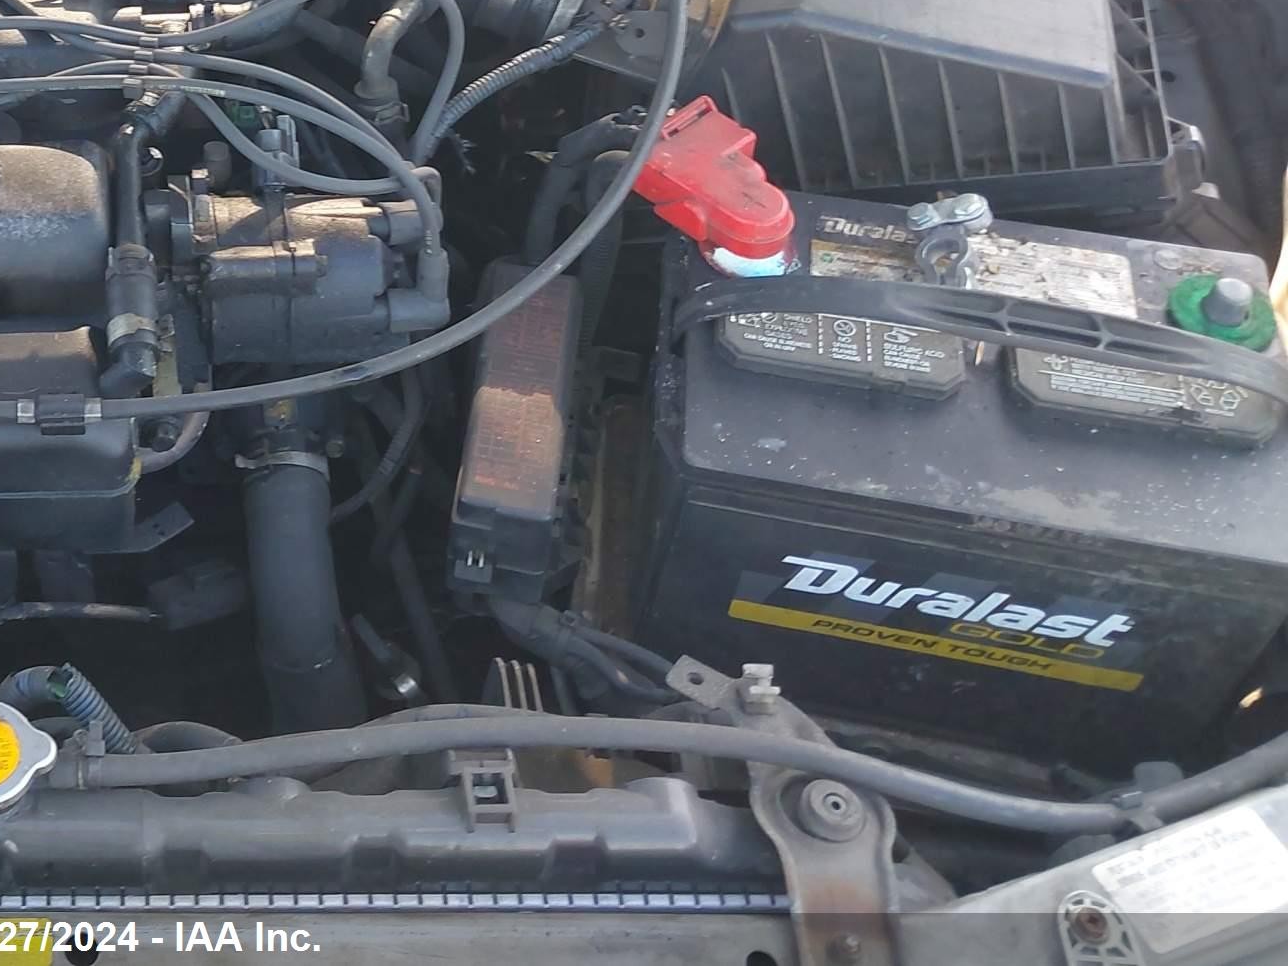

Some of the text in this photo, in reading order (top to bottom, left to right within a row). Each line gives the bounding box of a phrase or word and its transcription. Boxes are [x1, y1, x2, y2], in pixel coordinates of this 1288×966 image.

[781, 555, 1131, 648] Duralast
[811, 619, 1056, 672] PROVEN TOUGH
[949, 622, 1105, 660] GOLD
